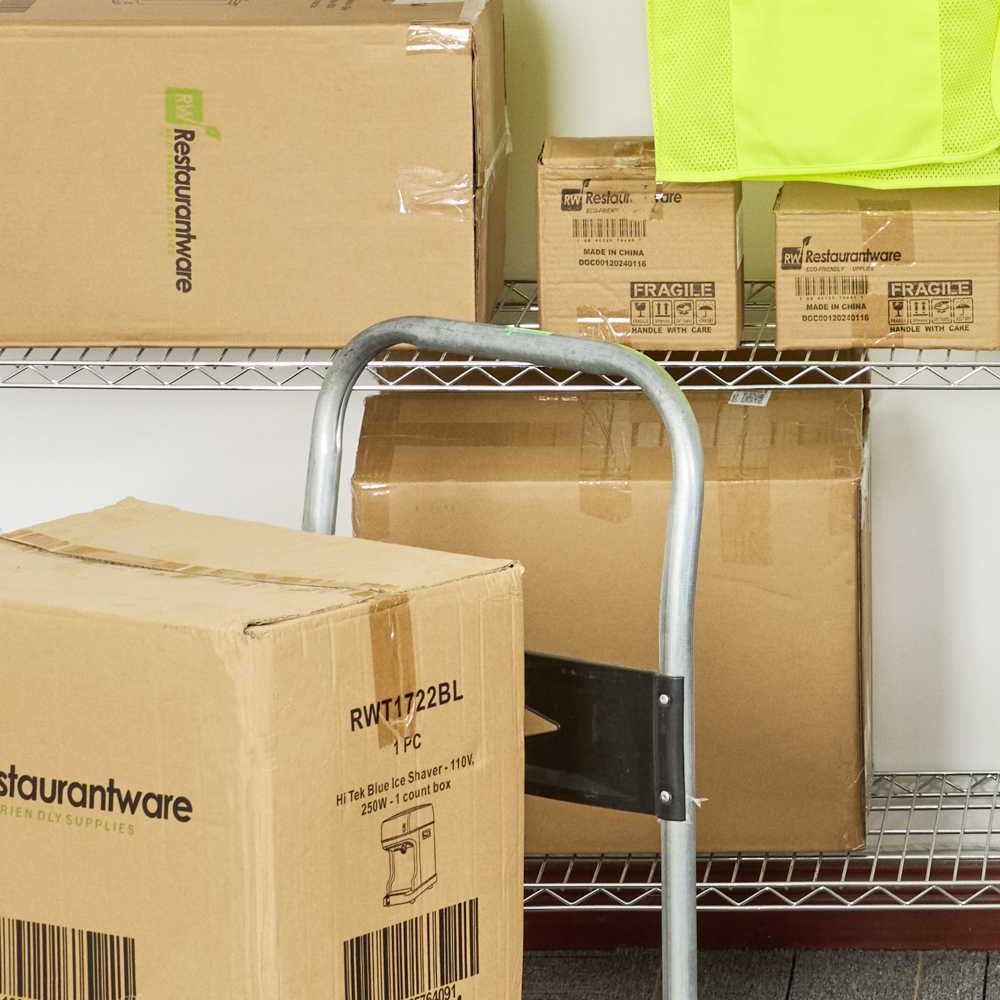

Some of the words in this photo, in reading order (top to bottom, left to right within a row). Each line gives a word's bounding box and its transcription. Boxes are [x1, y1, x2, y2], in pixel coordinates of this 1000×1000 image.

[175, 94, 193, 121] RW
[174, 128, 197, 294] Restaurantware
[564, 194, 581, 206] RW
[784, 253, 802, 265] RW
[805, 248, 902, 264] Restaurantware
[633, 283, 713, 297] FRAGILE
[890, 281, 970, 297] FRAGILE
[631, 326, 663, 334] HANDLE
[667, 326, 687, 334] WITH
[691, 326, 712, 334] CARE
[350, 679, 464, 732] RWT1722BL
[393, 738, 399, 756] 1
[403, 733, 422, 753] PC
[336, 791, 346, 806] Hi
[348, 787, 365, 802] Tek
[367, 781, 390, 797] Blue
[392, 776, 405, 789] Ice
[408, 765, 443, 784] Shaver
[450, 753, 475, 772] 110V,
[361, 797, 387, 816] 250W
[396, 794, 400, 805] 1
[402, 784, 431, 803] count
[433, 778, 452, 794] box
[65, 814, 136, 836] SUPPLIES
